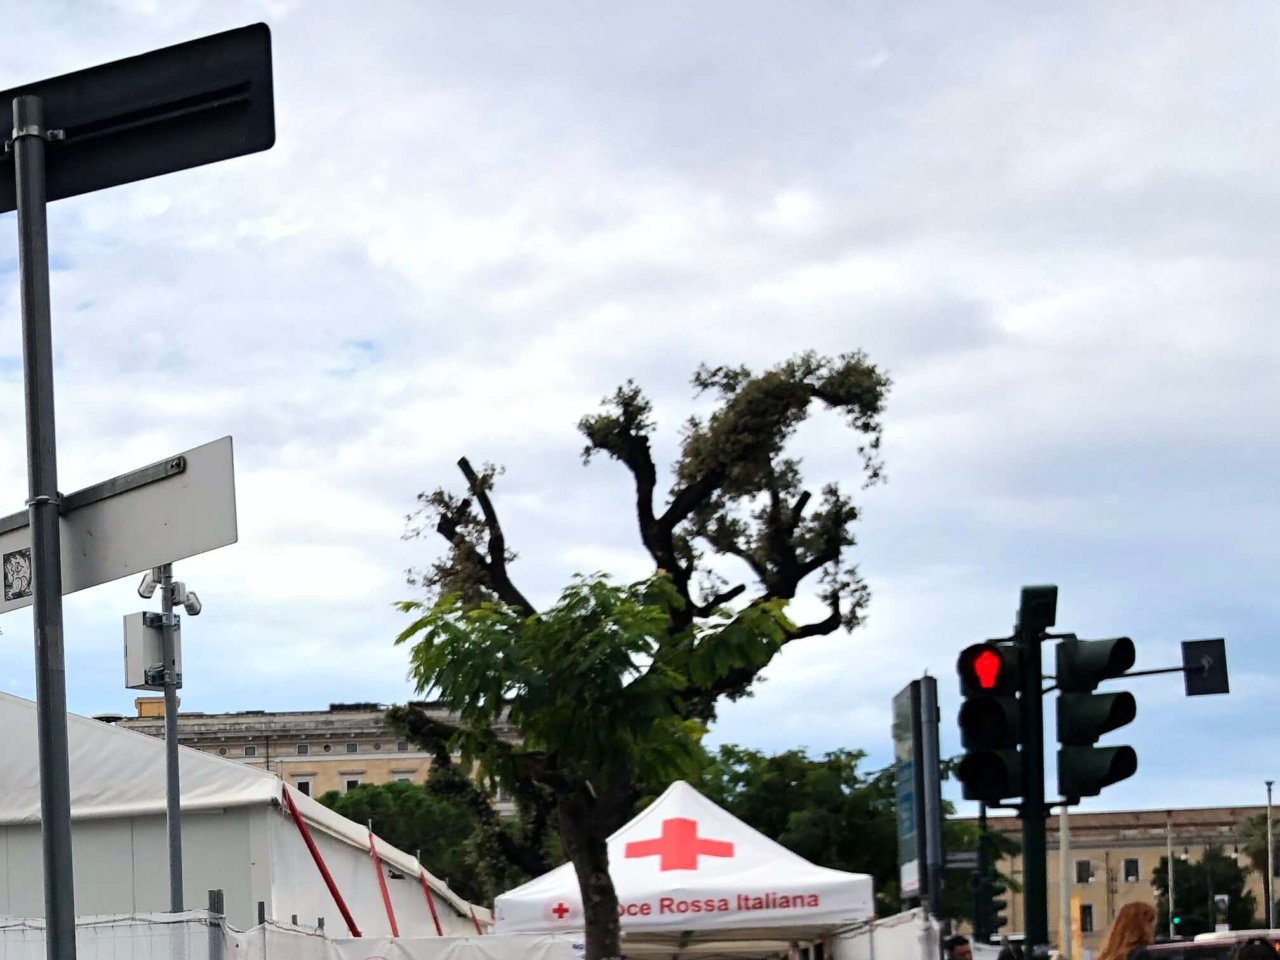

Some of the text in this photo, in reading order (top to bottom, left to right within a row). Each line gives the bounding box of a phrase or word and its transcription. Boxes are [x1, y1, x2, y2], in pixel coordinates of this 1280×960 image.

[616, 891, 819, 917] oce Rossa Italiana
